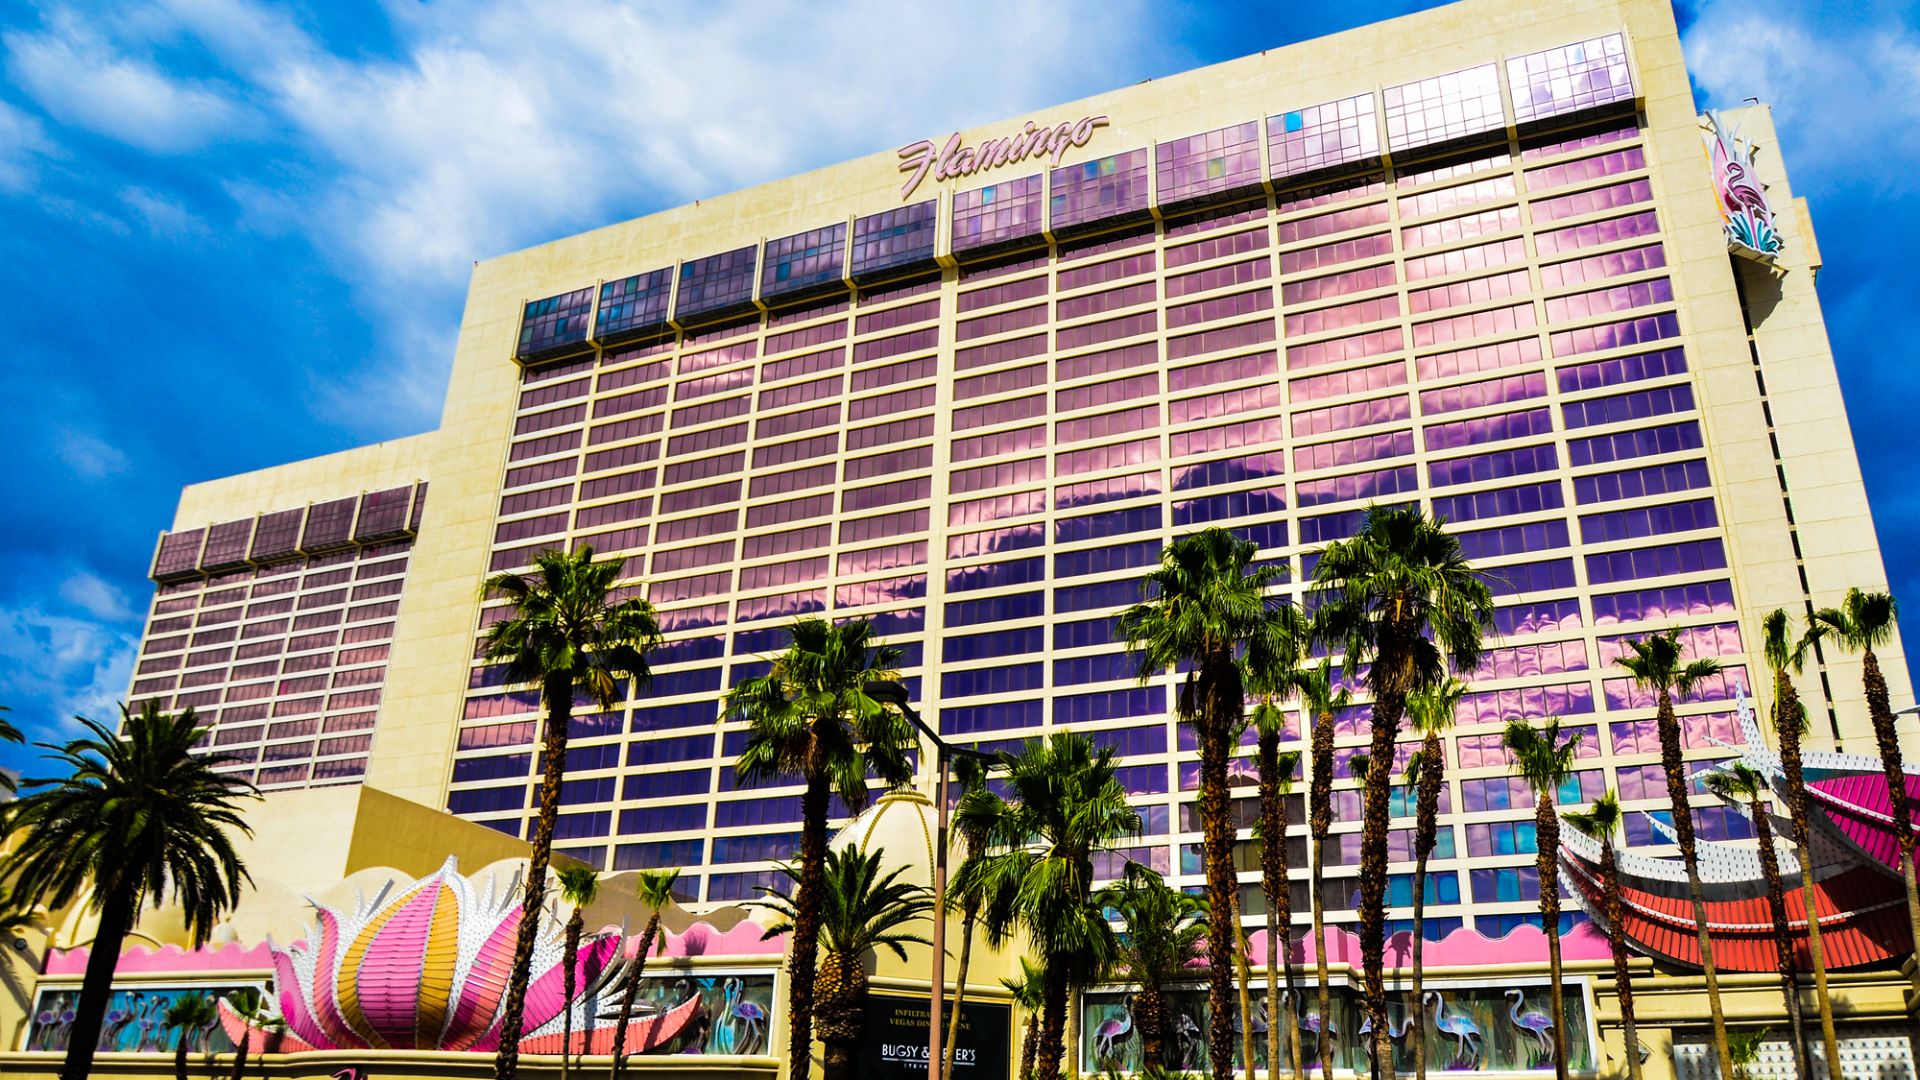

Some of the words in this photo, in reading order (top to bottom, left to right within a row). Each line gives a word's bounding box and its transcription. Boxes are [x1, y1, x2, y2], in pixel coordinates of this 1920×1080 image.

[897, 115, 1110, 201] Flamingo
[895, 1008, 949, 1020] INFILTRAG
[889, 1018, 915, 1026] VEGAS
[882, 1043, 919, 1058] BUGSY
[921, 1046, 930, 1059] &
[942, 1047, 976, 1062] EER'S
